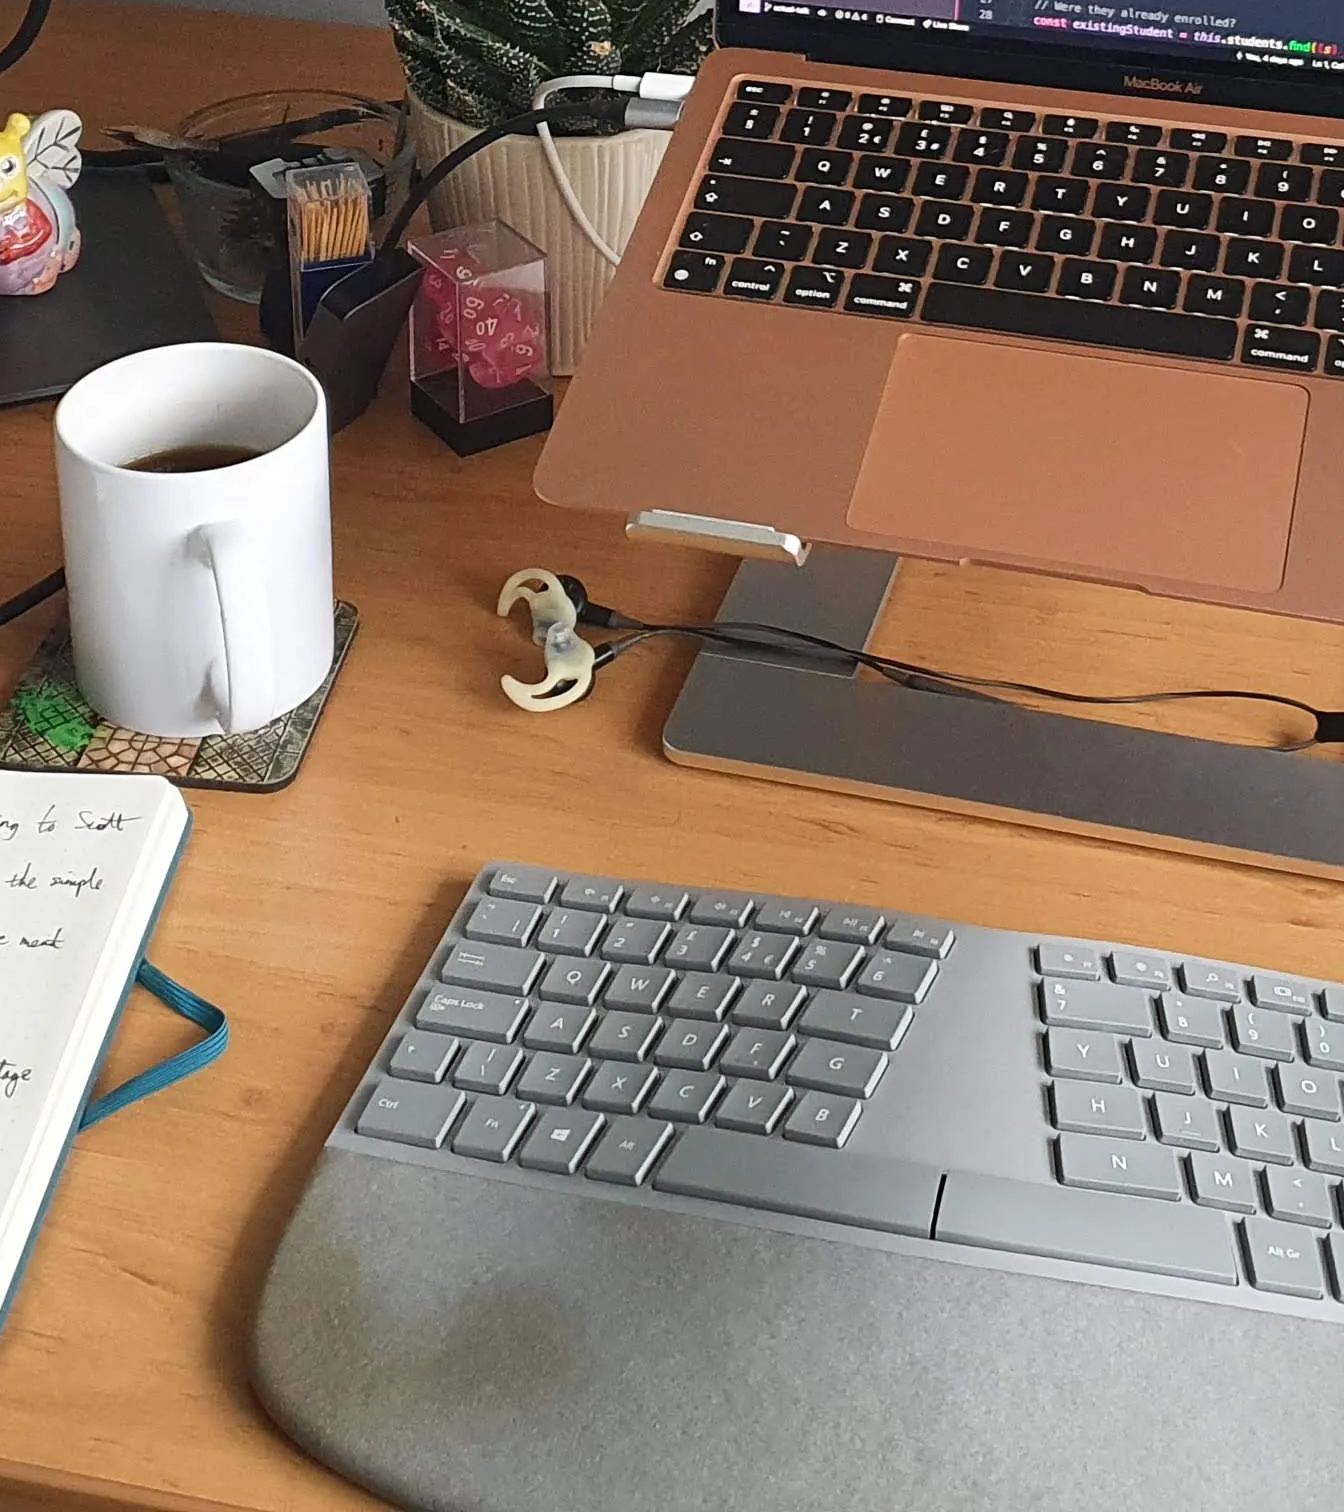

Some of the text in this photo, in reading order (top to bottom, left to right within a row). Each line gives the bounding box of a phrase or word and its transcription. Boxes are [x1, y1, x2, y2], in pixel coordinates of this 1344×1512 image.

[1054, 0, 1236, 30] Were they already enrolled?
[1123, 75, 1204, 96] MacBook Air
[731, 279, 770, 293] control
[794, 287, 830, 302] option
[853, 295, 908, 312] command
[1250, 348, 1309, 364] command
[38, 805, 57, 835] to
[74, 809, 142, 833] Scott
[6, 868, 38, 891] the
[50, 868, 103, 897] simple
[434, 994, 485, 1011] Caps Lock
[378, 1098, 400, 1110] Ctrl
[1267, 1244, 1302, 1260] Alt Gr
